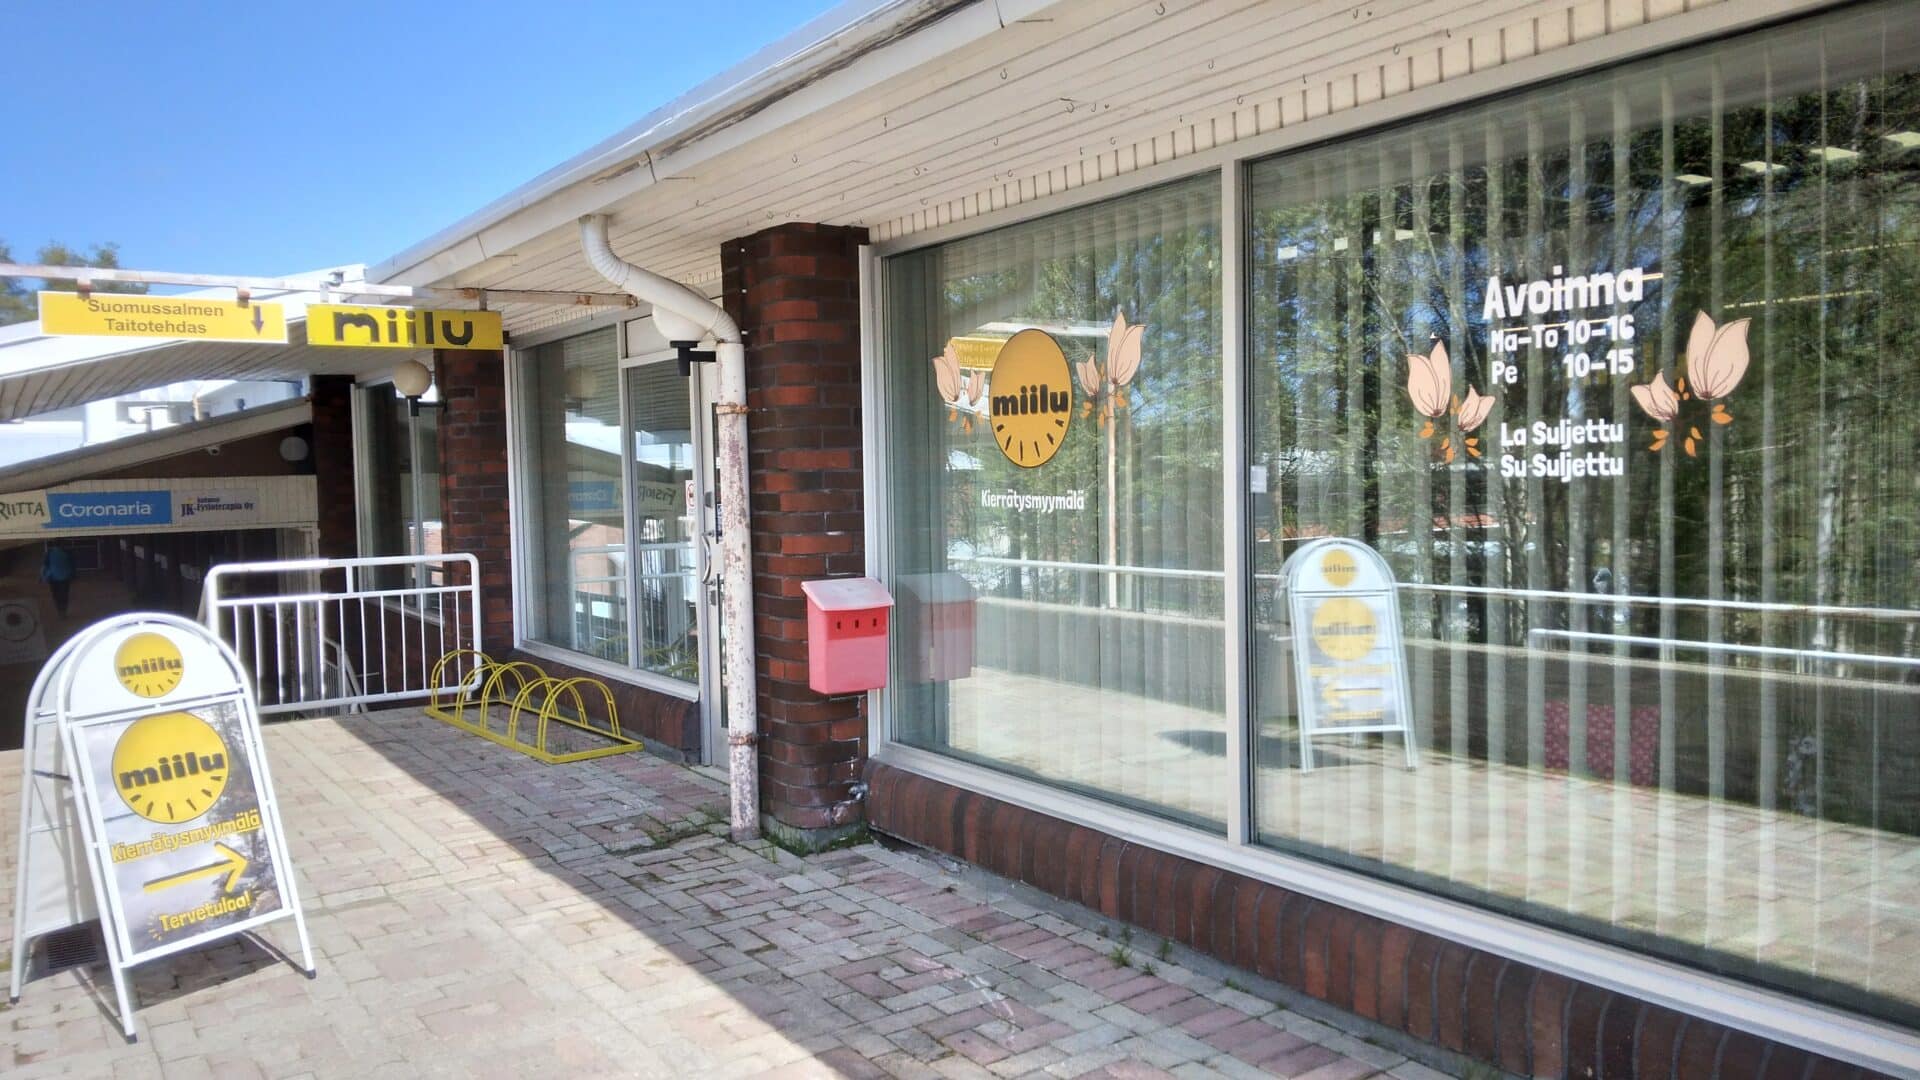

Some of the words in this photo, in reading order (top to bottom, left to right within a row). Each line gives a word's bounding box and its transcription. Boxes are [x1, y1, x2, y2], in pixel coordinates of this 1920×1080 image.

[88, 299, 224, 317] Suomussalmen
[1483, 265, 1643, 320] Avoinna
[104, 318, 207, 334] Taitotehdas
[332, 309, 473, 345] miilu
[1564, 314, 1635, 347] 10-16
[1492, 361, 1518, 385] Pe
[1563, 348, 1635, 379] 10-15
[992, 385, 1068, 416] miilu
[1500, 422, 1527, 446] La
[1532, 418, 1624, 450] Suljettu
[1500, 454, 1527, 477] Su
[1532, 451, 1624, 483] Suljettu
[59, 501, 152, 517] Coronaria
[981, 488, 1085, 513] Kierrätysmyymälä
[118, 657, 182, 677] miilu
[120, 752, 225, 790] miilu
[111, 809, 261, 863] Kierrätysmyymälä
